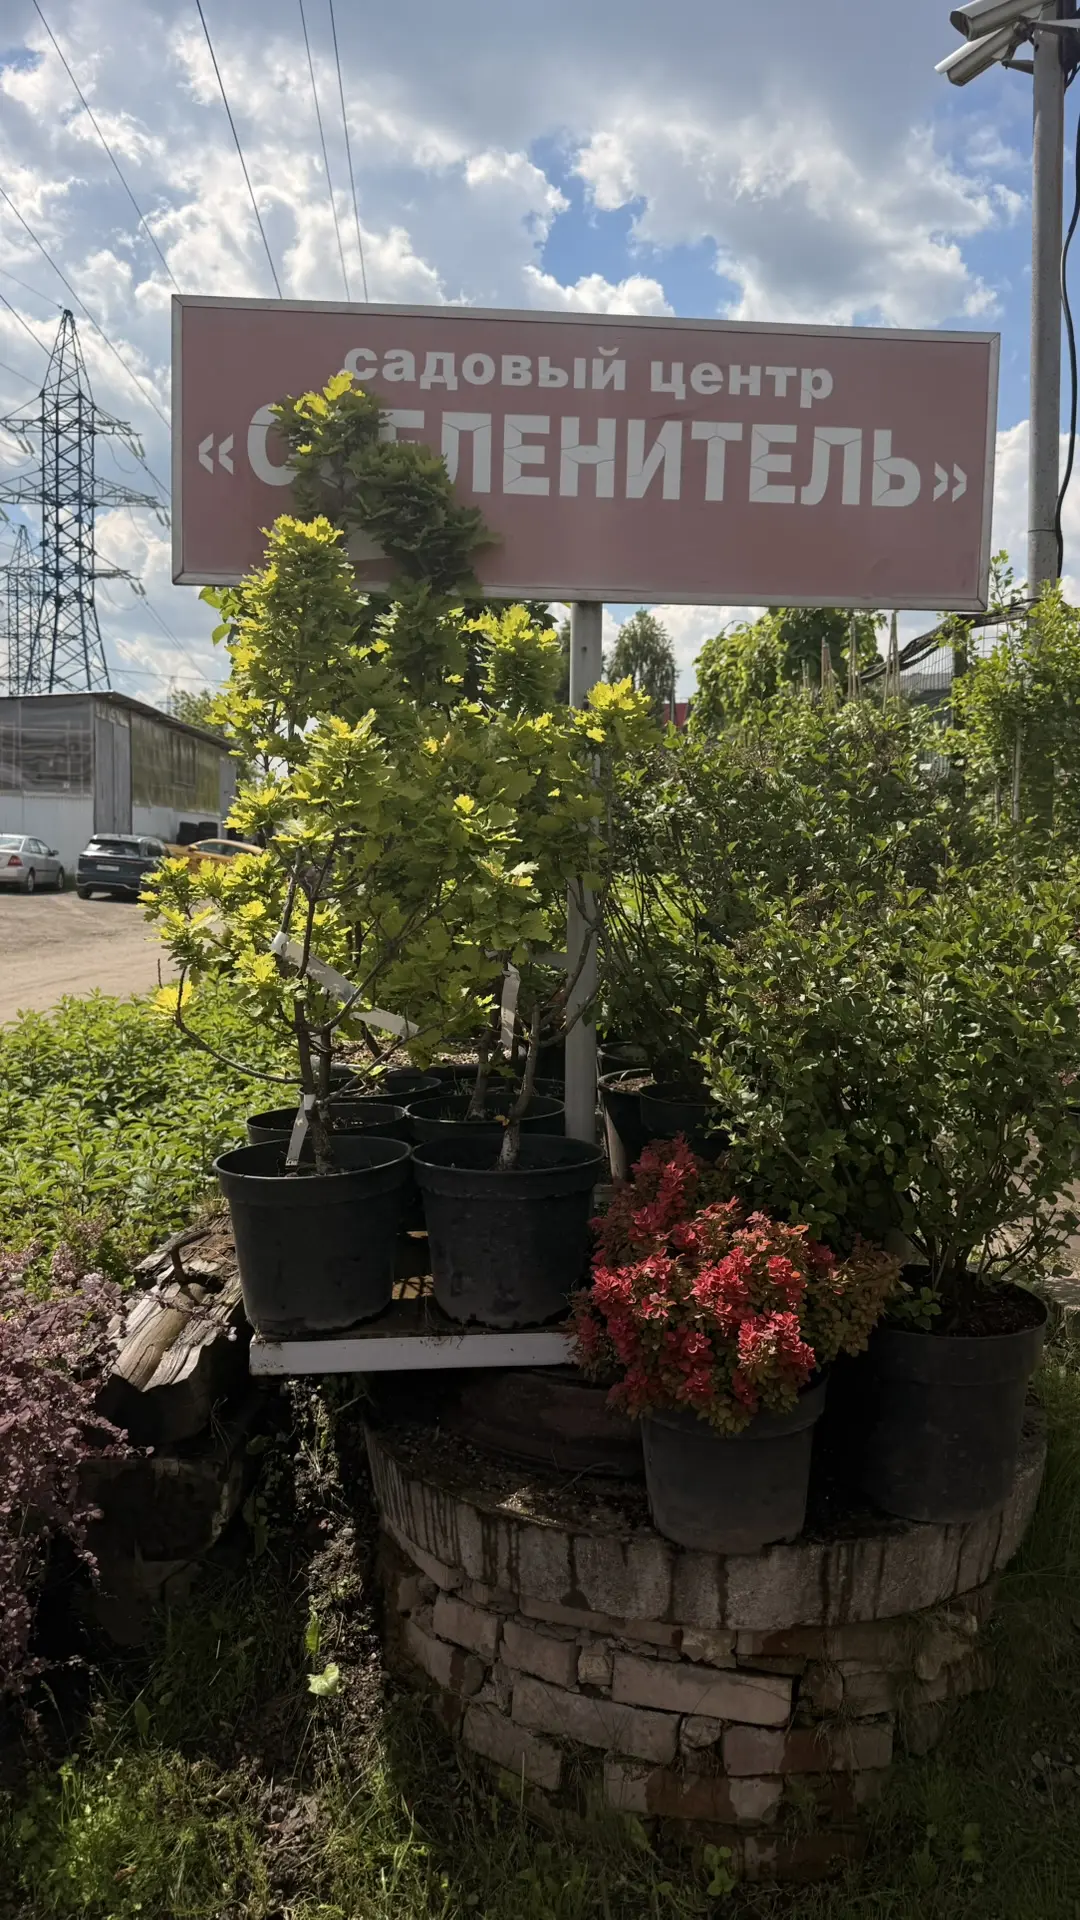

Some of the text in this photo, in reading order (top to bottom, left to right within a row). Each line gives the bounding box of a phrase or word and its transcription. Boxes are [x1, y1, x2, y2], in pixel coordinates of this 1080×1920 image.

[344, 346, 834, 409] садовый центр
[198, 402, 968, 508] «ОЛЕНИТЕЛЬ»
